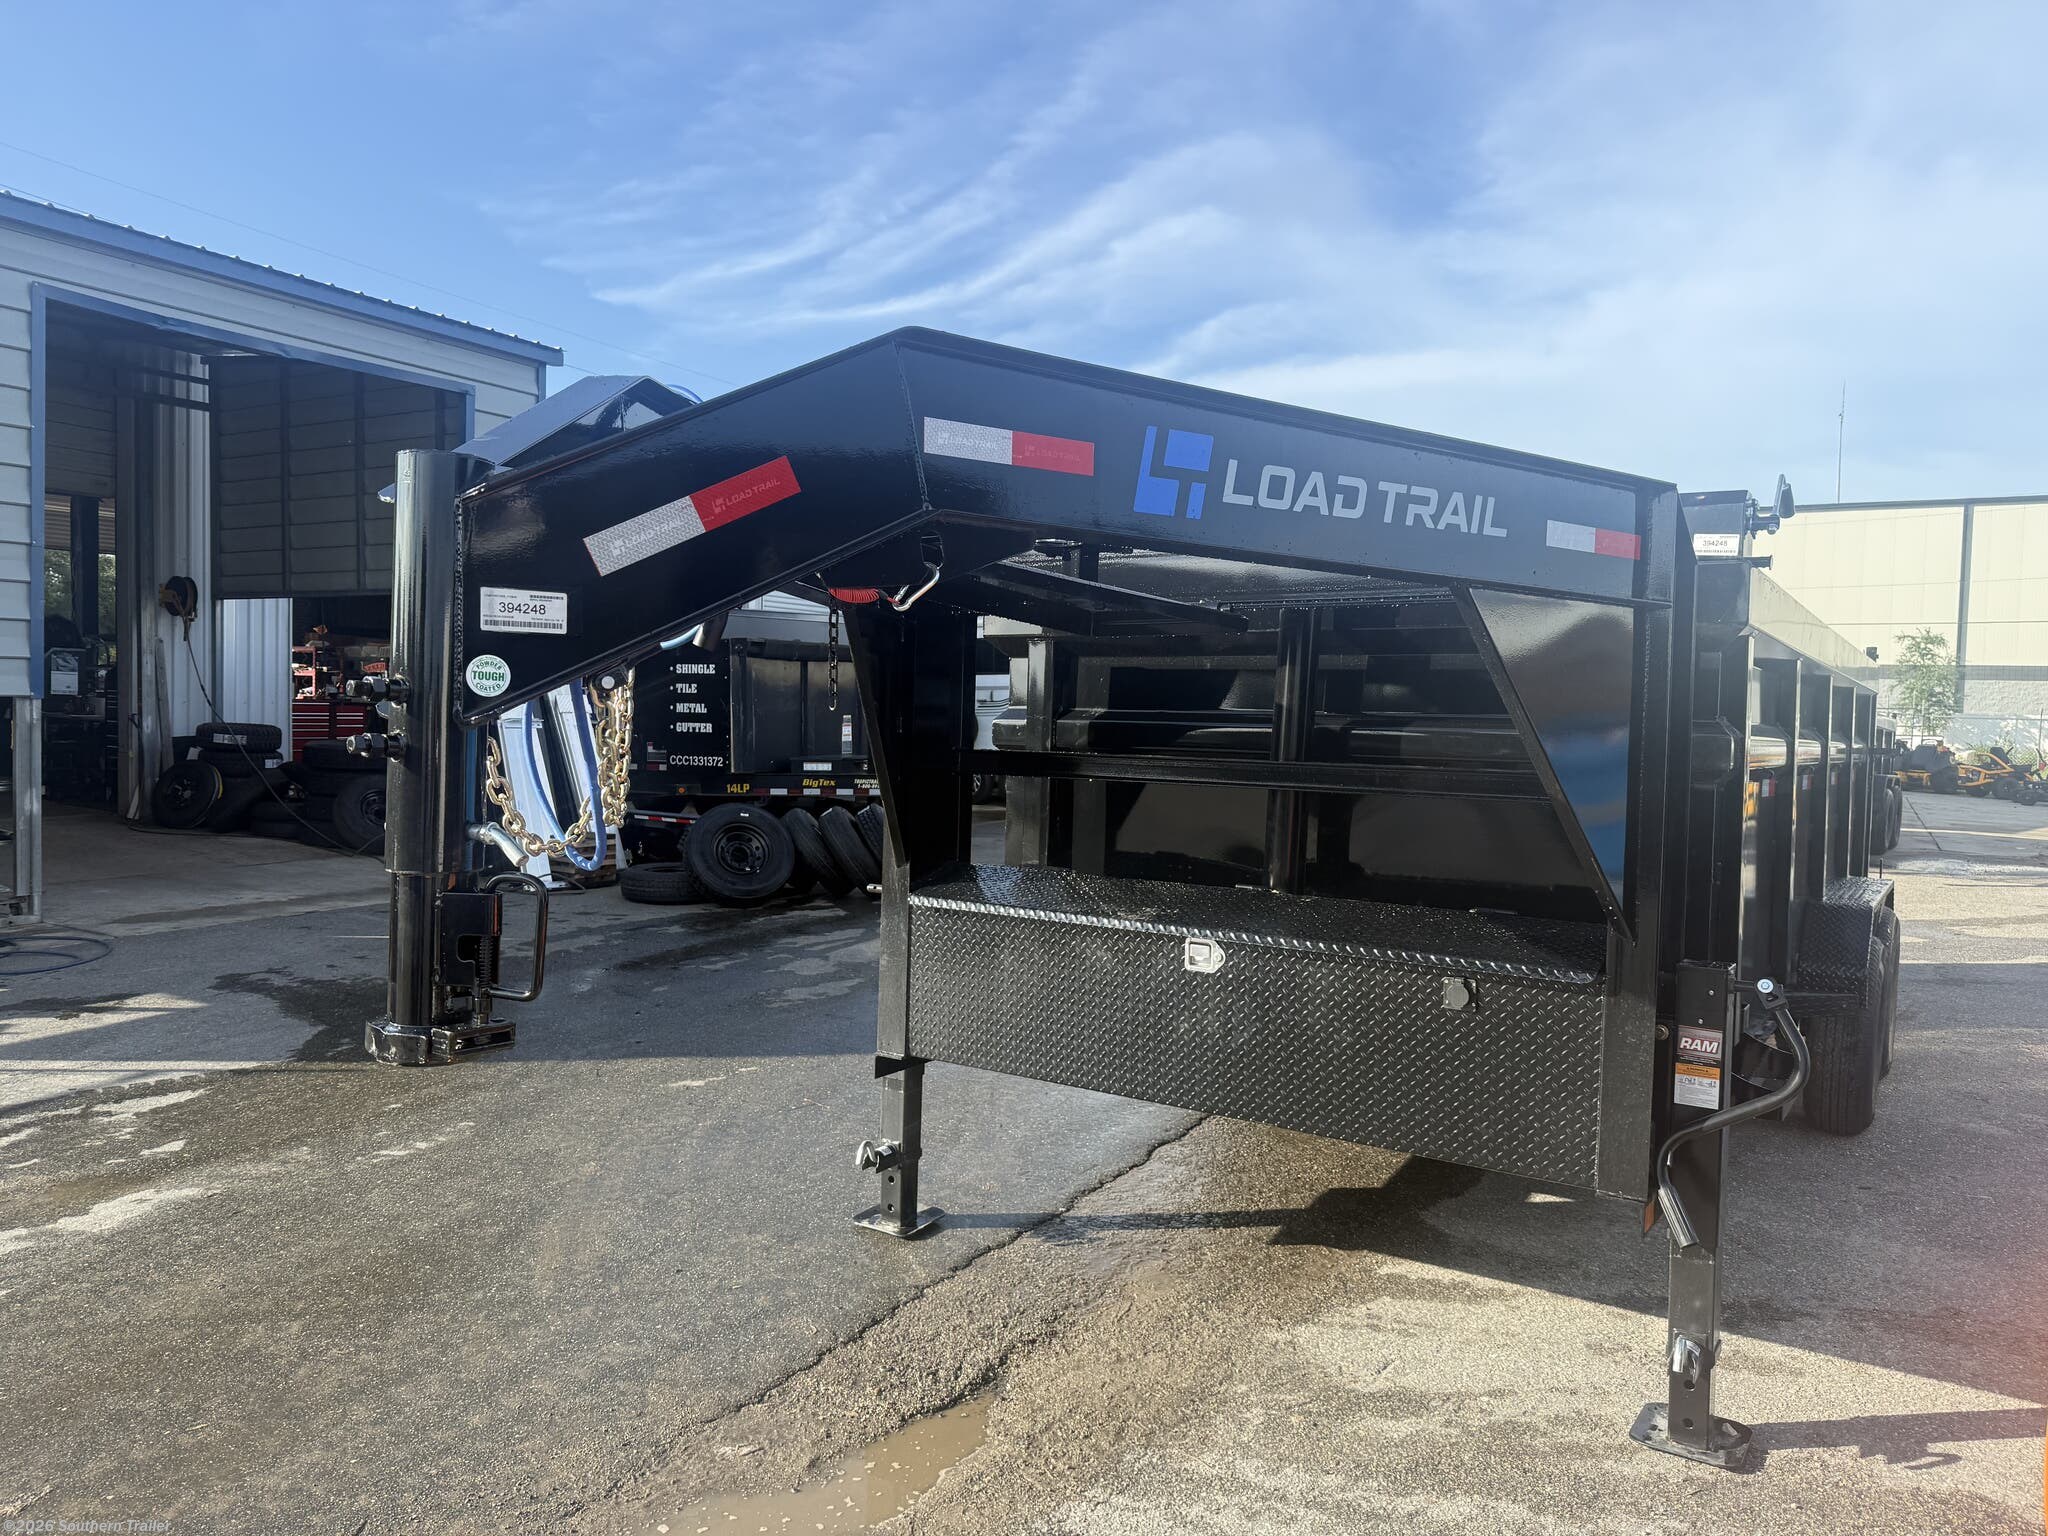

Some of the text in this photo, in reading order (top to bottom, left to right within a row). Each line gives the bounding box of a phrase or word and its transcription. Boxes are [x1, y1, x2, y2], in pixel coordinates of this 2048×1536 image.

[726, 478, 781, 506] LOAD TRAIL
[1222, 458, 1509, 538] LOAD TRAIL
[498, 601, 546, 615] 394248
[476, 660, 502, 671] POWDER
[675, 663, 716, 675] SHINGLE
[472, 670, 505, 682] TOUGH
[475, 682, 501, 692] COATED
[675, 683, 698, 694] TILE
[675, 702, 708, 714] METAL
[675, 722, 713, 733] GUTTER
[669, 754, 724, 767] CCC1331372
[726, 783, 750, 794] 14LP
[802, 778, 837, 788] BigTex
[1680, 1036, 1719, 1054] RAM
